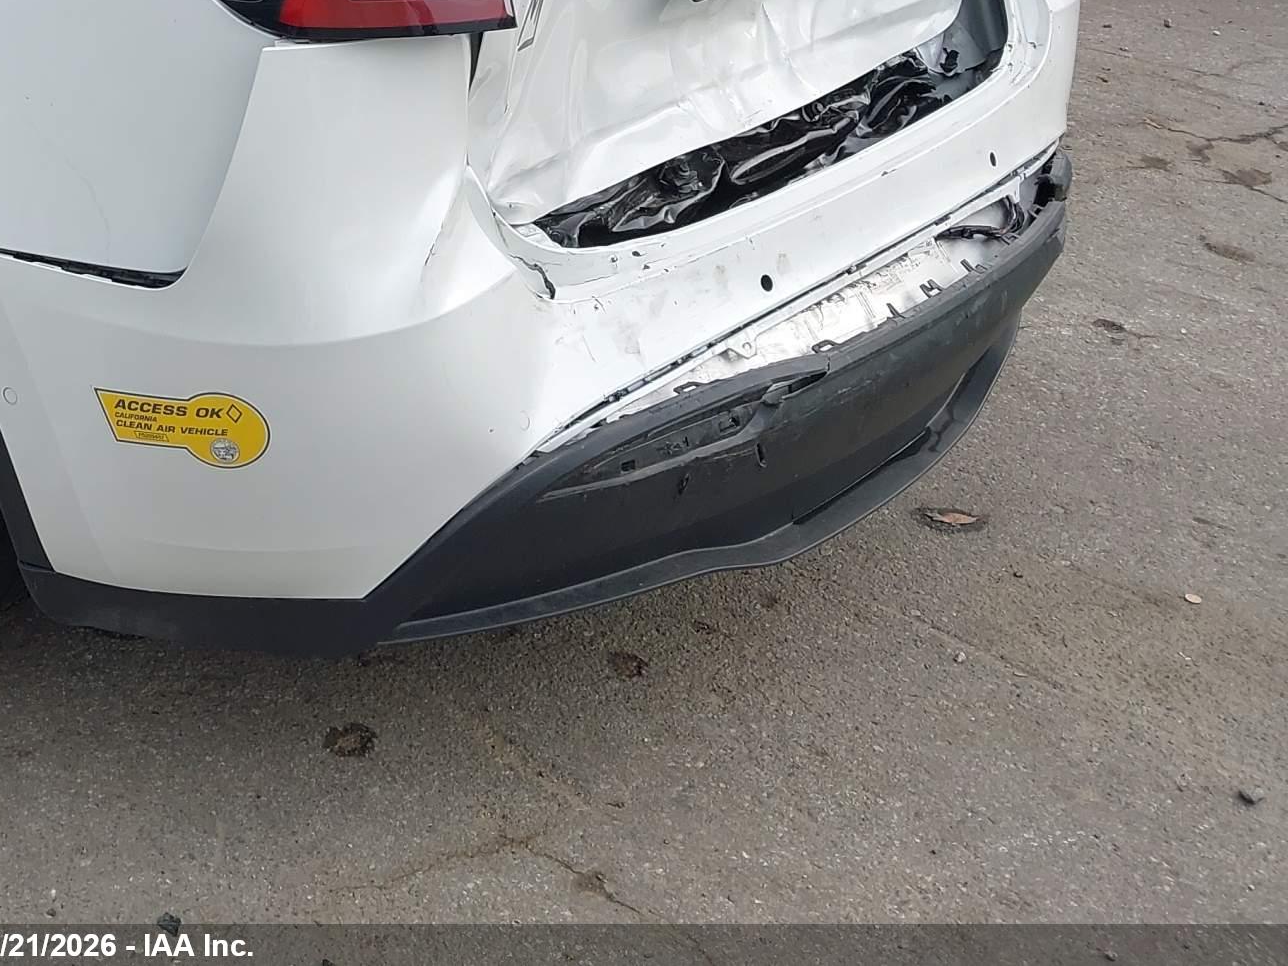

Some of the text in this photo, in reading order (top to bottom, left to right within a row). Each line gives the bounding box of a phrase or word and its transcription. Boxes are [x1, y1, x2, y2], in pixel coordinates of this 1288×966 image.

[114, 398, 224, 419] ACCESS OK
[114, 411, 158, 423] CALIFORNIA
[116, 419, 229, 437] CLEAN AIR VEHICLE
